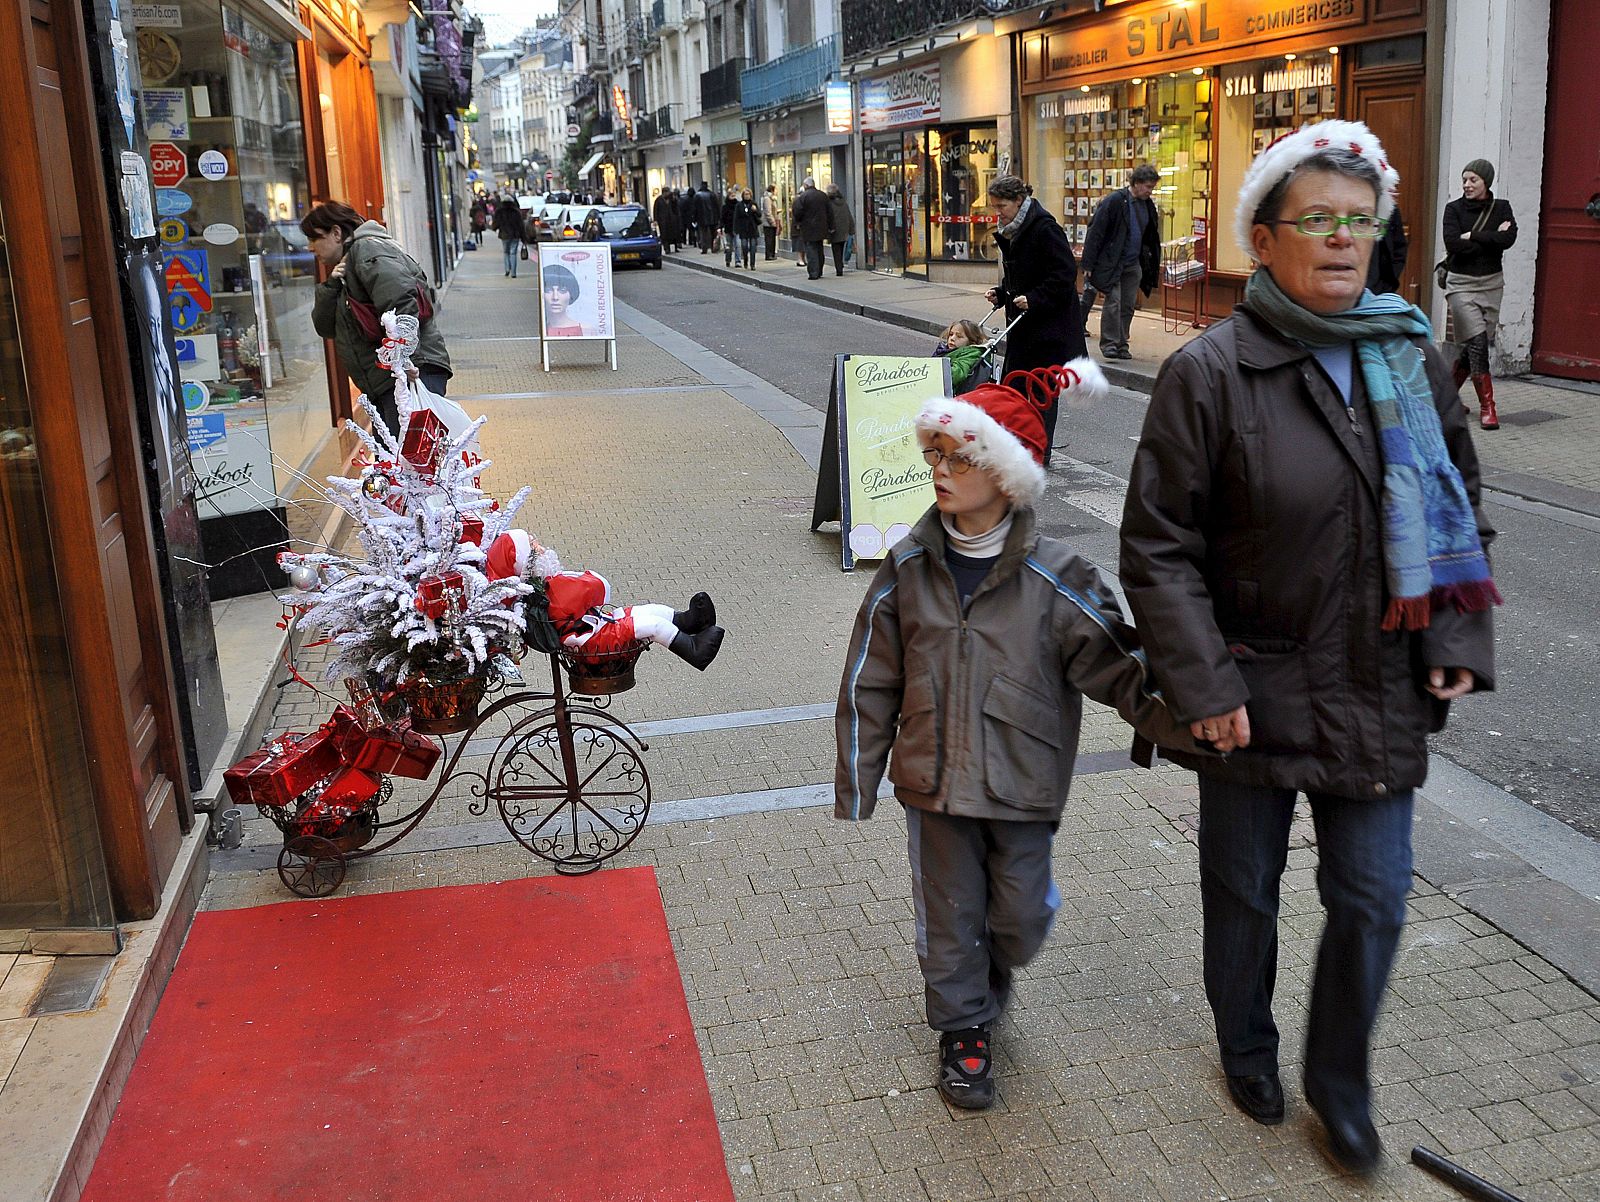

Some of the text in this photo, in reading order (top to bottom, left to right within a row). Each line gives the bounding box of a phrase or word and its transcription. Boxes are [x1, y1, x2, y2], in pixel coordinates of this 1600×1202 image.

[1052, 0, 1354, 72] IMMOBILIER STAL COMMERCES
[1226, 63, 1332, 97] STAL IMMOBILIER
[1040, 94, 1111, 119] STAL IMMOBILIER
[150, 159, 182, 171] OPY
[938, 215, 993, 223] 02 35 40
[595, 253, 607, 335] SANS RENDEZ-VOUS
[855, 360, 931, 387] Paraboot
[861, 463, 934, 493] Paraboot
